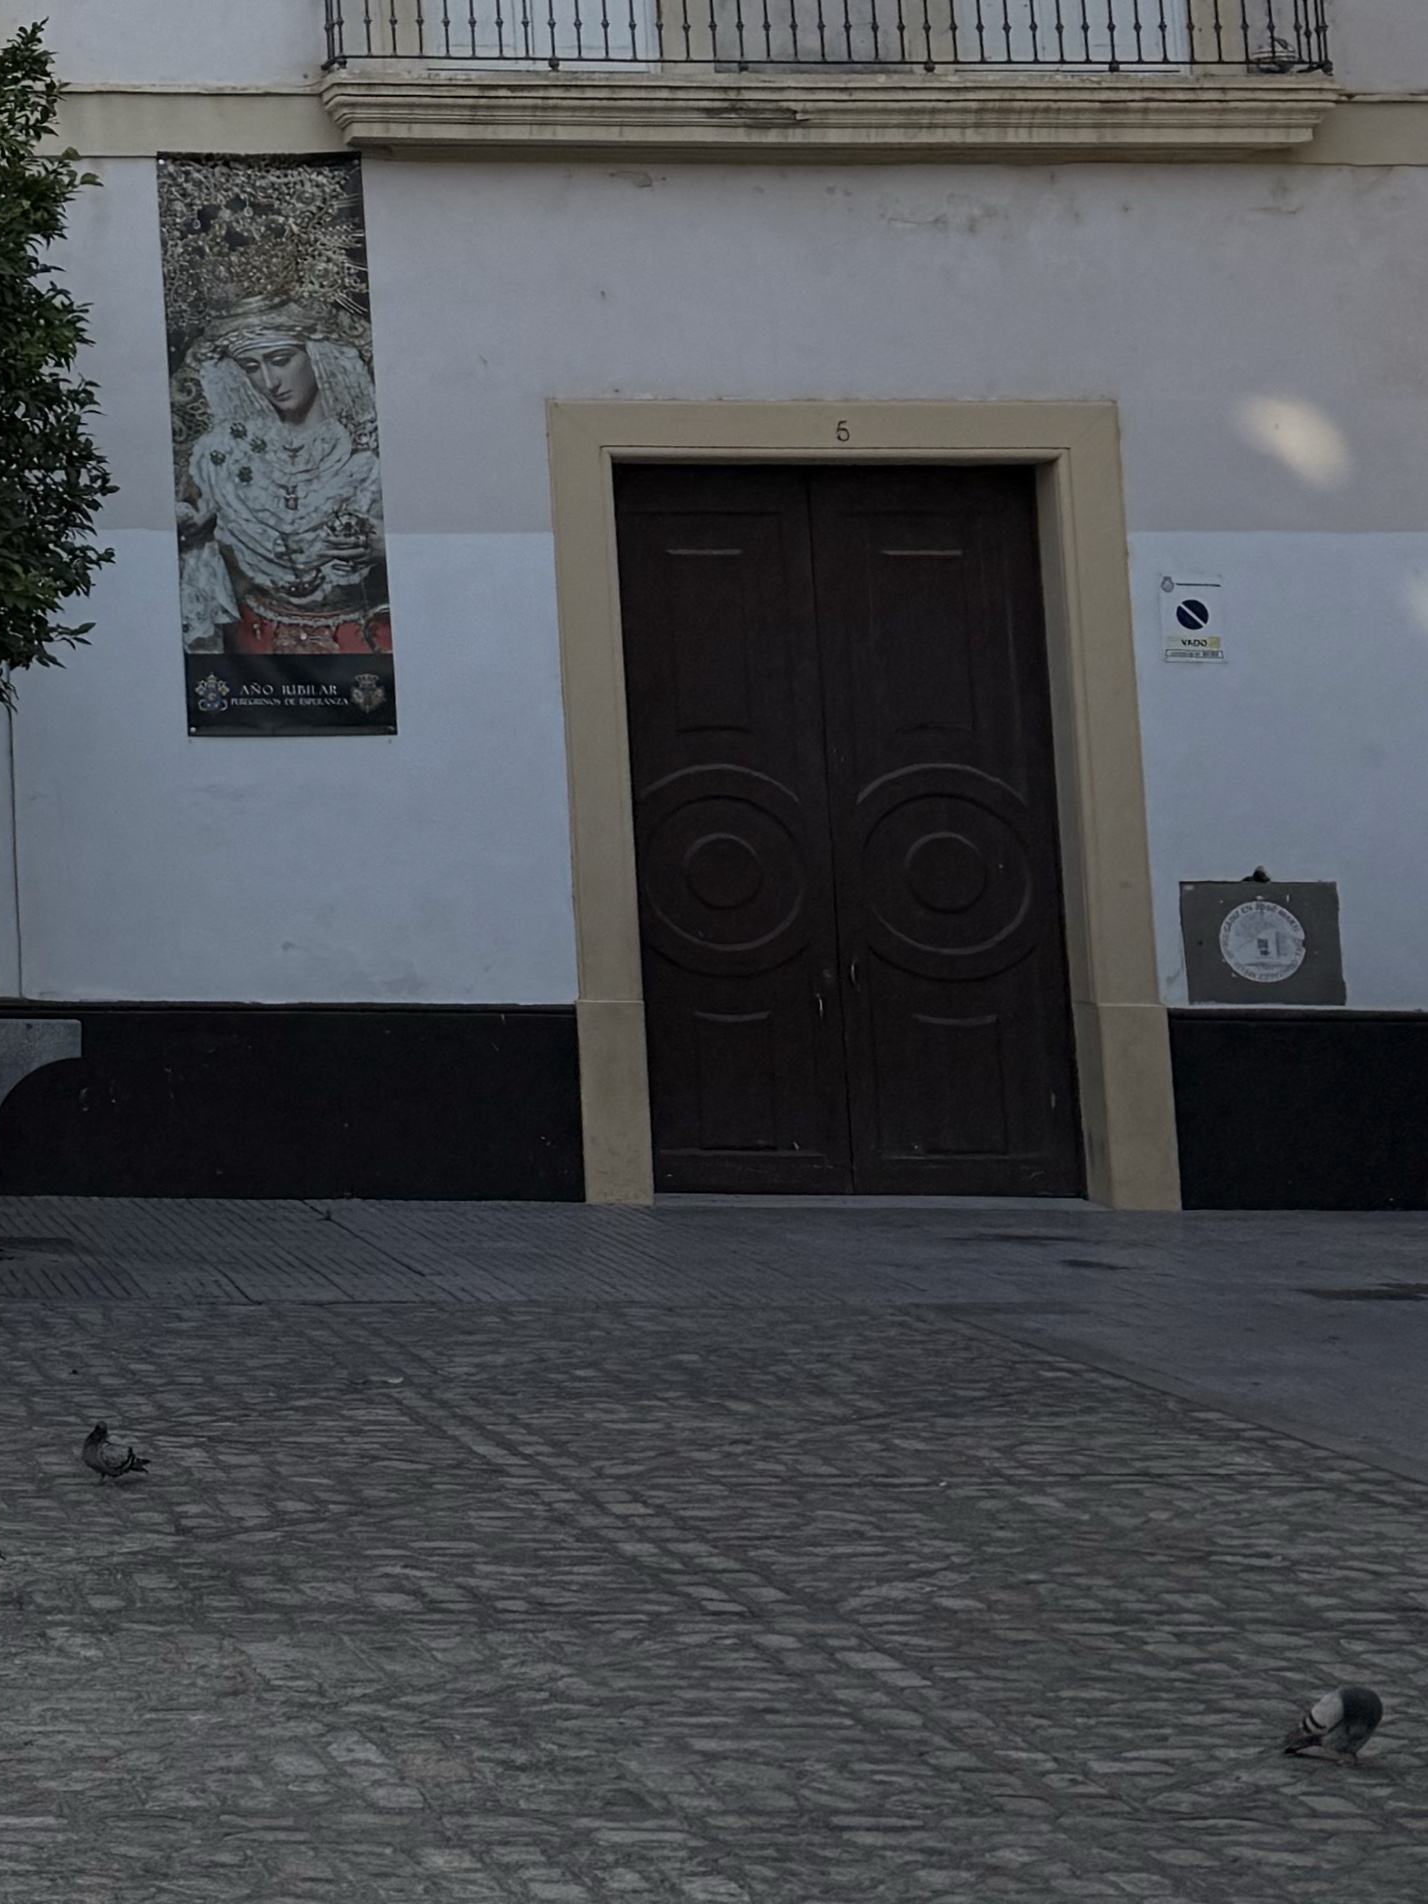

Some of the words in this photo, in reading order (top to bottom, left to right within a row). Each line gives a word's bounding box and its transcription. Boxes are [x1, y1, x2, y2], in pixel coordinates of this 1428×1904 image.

[836, 420, 850, 442] 5
[1181, 638, 1208, 647] VADO
[239, 682, 275, 696] AÑO
[230, 697, 282, 706] PEREGRINOS
[284, 697, 295, 706] DE
[298, 697, 350, 706] ESPERANZA
